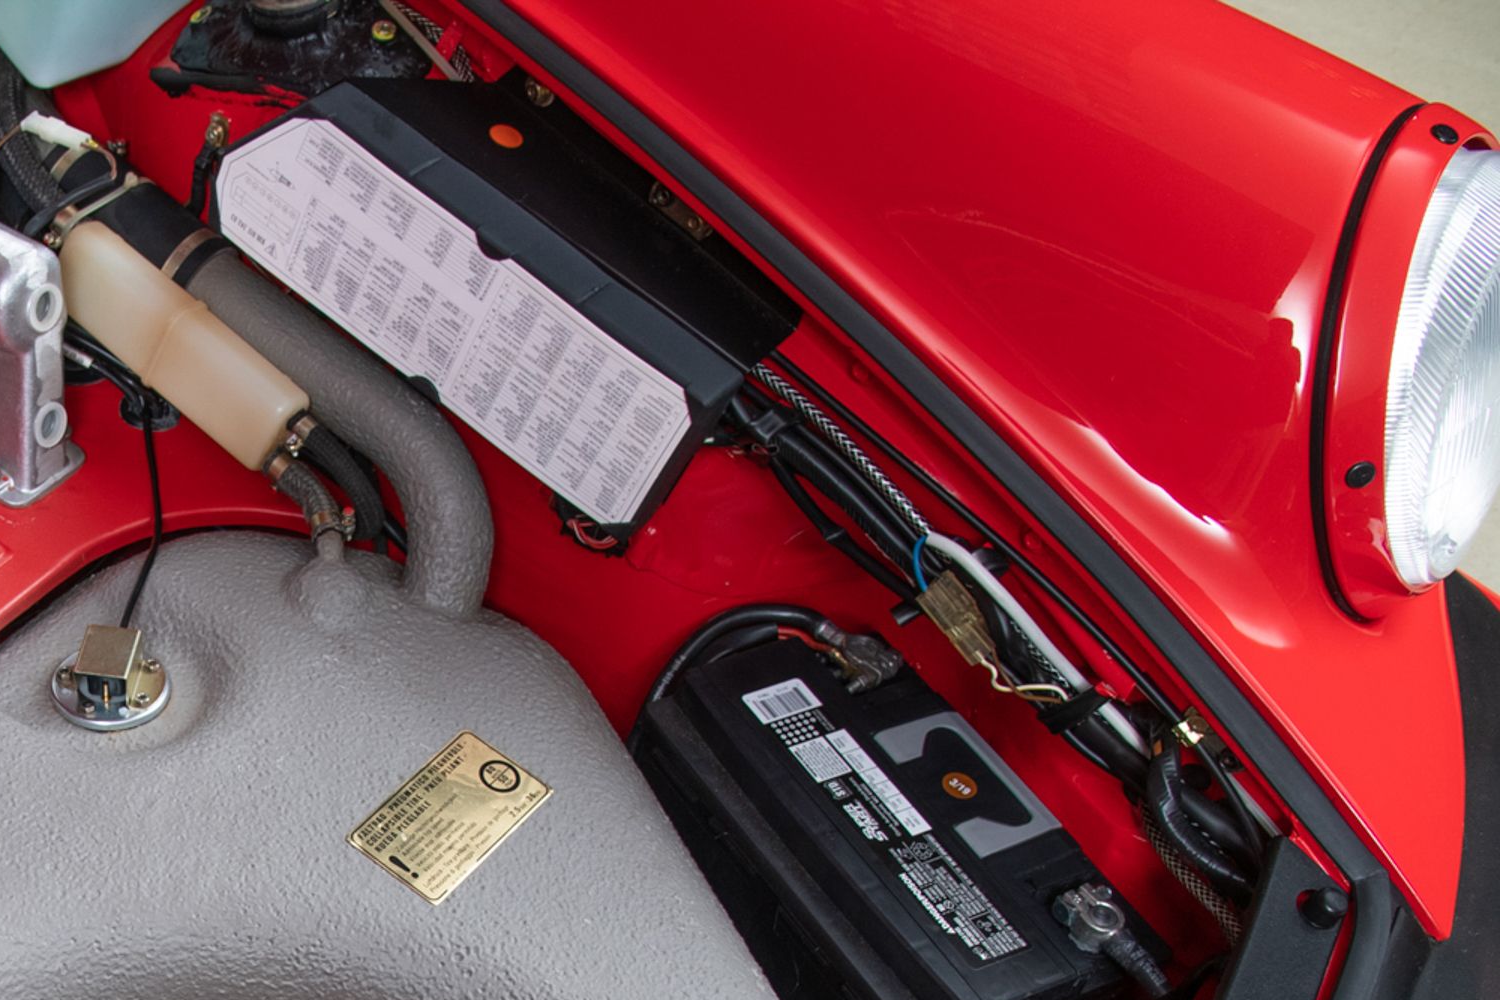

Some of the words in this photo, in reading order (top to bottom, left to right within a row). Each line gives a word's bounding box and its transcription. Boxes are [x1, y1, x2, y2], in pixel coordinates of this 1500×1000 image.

[364, 807, 409, 847] COLLAPSIBLE
[405, 792, 424, 809] TIRE
[422, 775, 444, 793] PNEU
[439, 754, 465, 778] PLIANT
[386, 773, 430, 812] PNEUMATICO
[426, 742, 464, 776] PIEGHEVOLE
